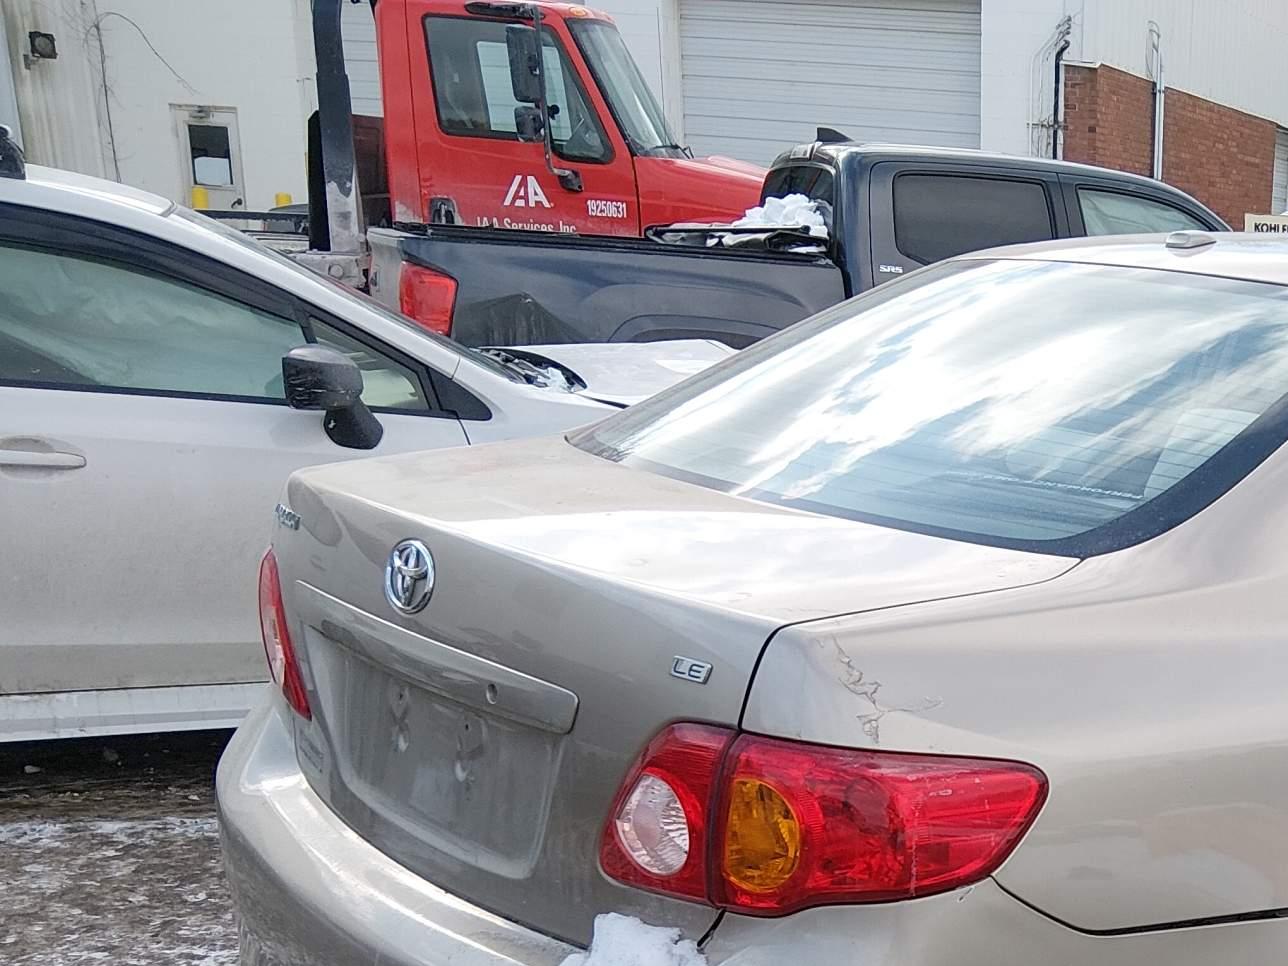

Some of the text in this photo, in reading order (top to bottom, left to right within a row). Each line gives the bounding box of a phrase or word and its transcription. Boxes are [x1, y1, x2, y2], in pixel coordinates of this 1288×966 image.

[503, 174, 554, 208] IAA
[587, 200, 627, 218] 19250631
[879, 264, 903, 274] SR5
[673, 658, 706, 679] LE
